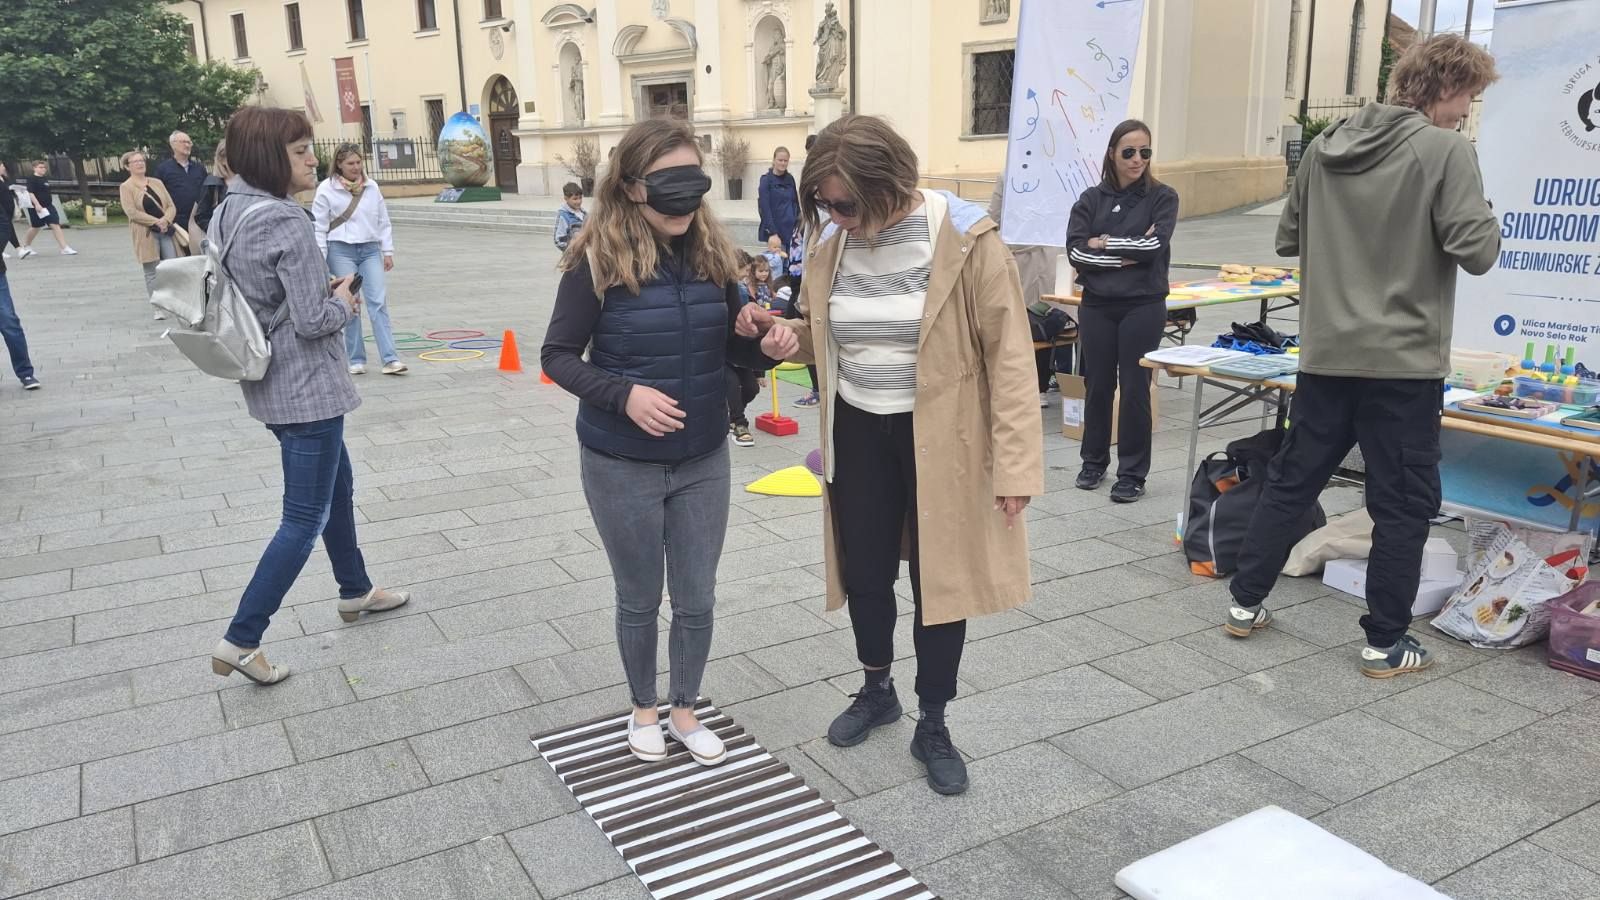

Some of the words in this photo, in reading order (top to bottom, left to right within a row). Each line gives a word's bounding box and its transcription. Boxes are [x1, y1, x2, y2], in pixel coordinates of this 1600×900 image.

[1562, 63, 1592, 94] UDRUGA
[1501, 212, 1600, 242] SINDROM
[1520, 328, 1545, 338] Novo
[1546, 331, 1567, 340] Selo
[1568, 333, 1588, 343] Rok
[1522, 319, 1546, 329] Ulica
[1547, 321, 1588, 333] Maršala
